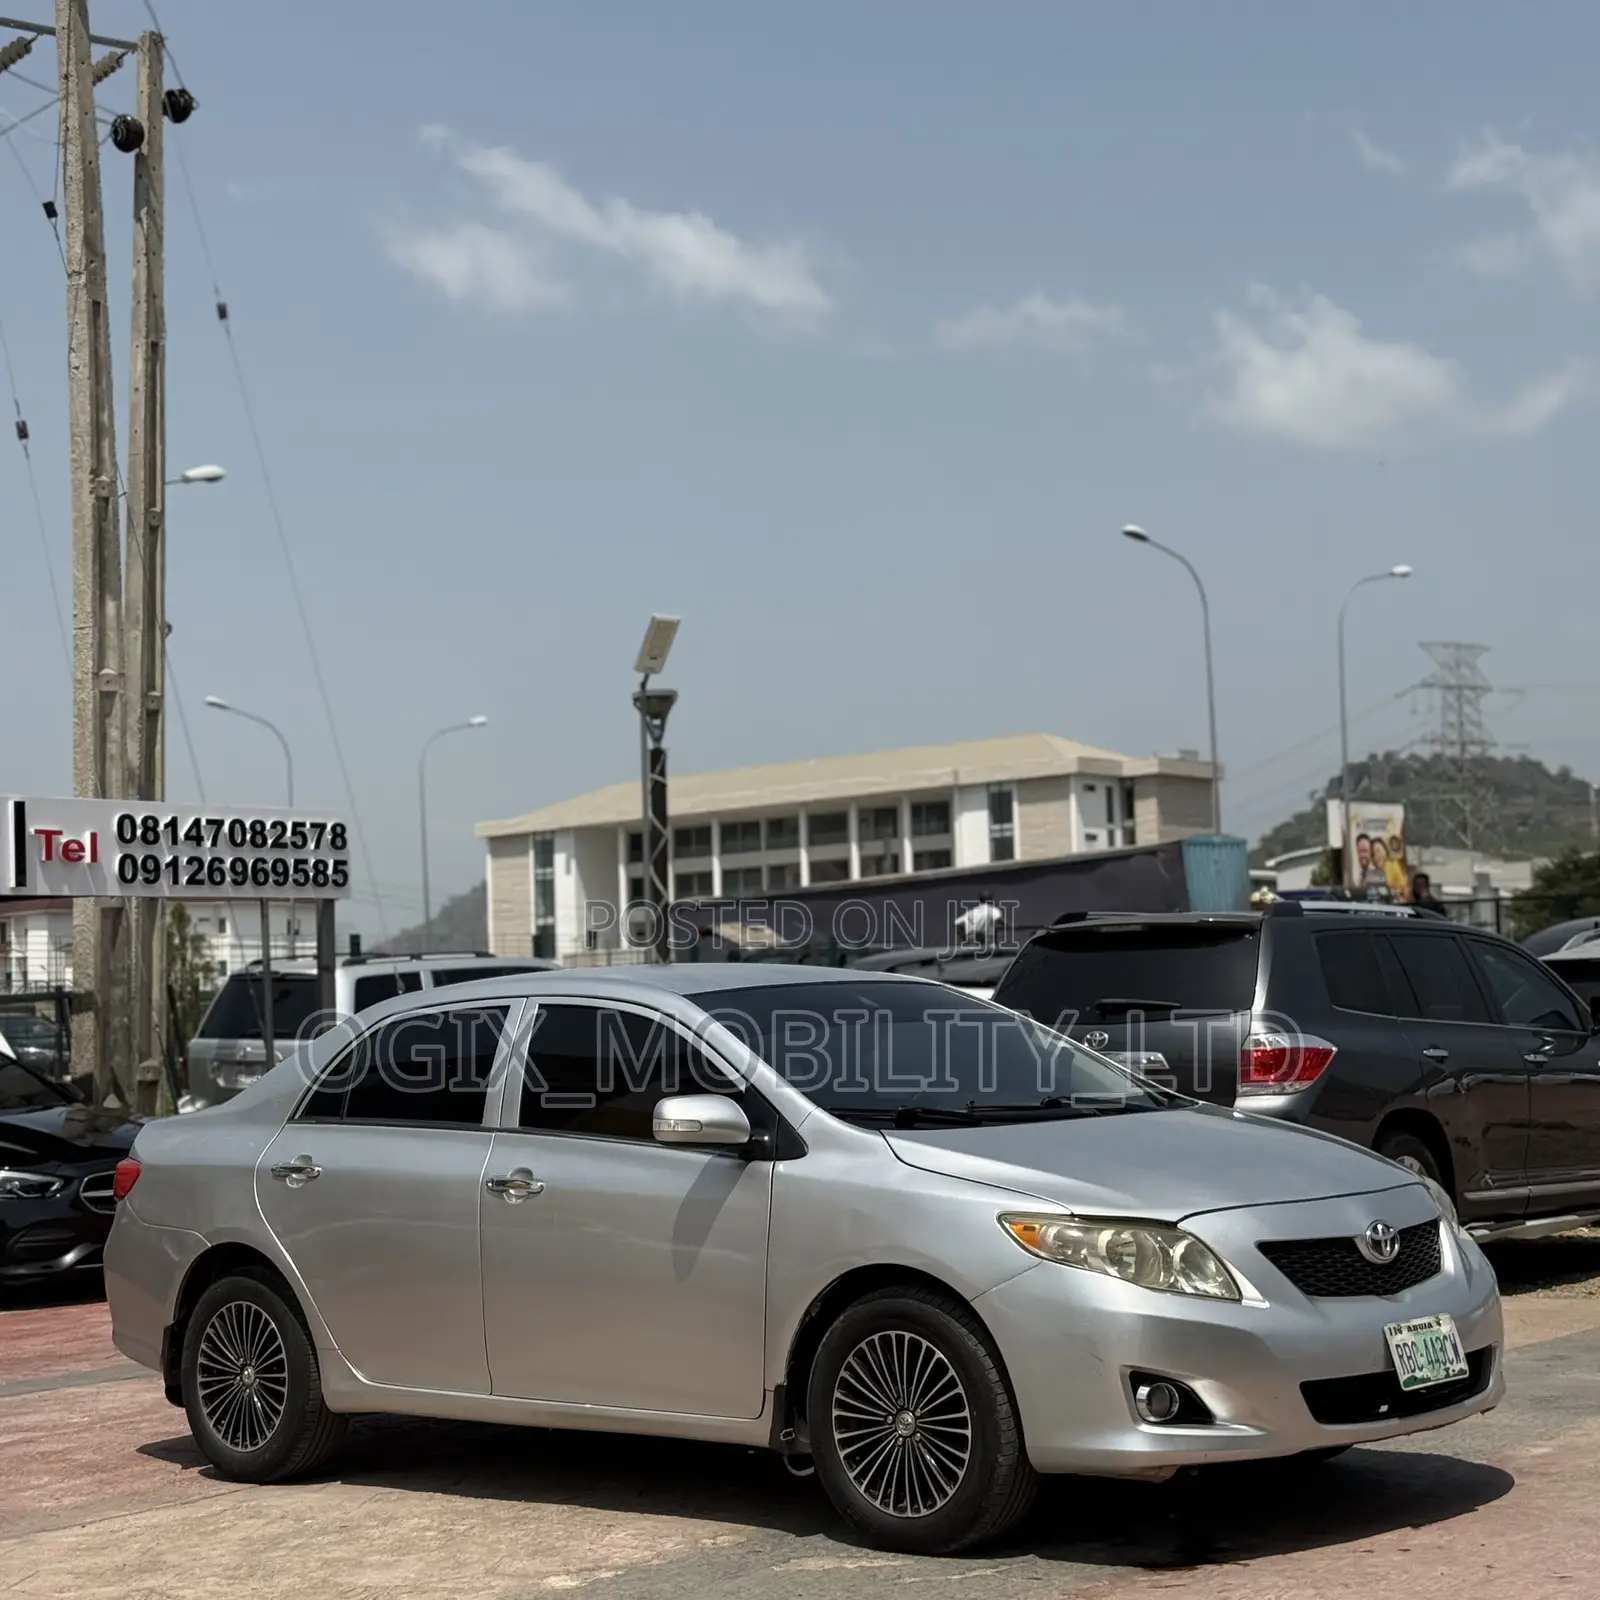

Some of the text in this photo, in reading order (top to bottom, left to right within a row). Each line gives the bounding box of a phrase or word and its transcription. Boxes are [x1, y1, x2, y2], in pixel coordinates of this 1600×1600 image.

[31, 828, 98, 863] Tel
[115, 813, 348, 851] 08147082578
[116, 852, 349, 888] 09126969585
